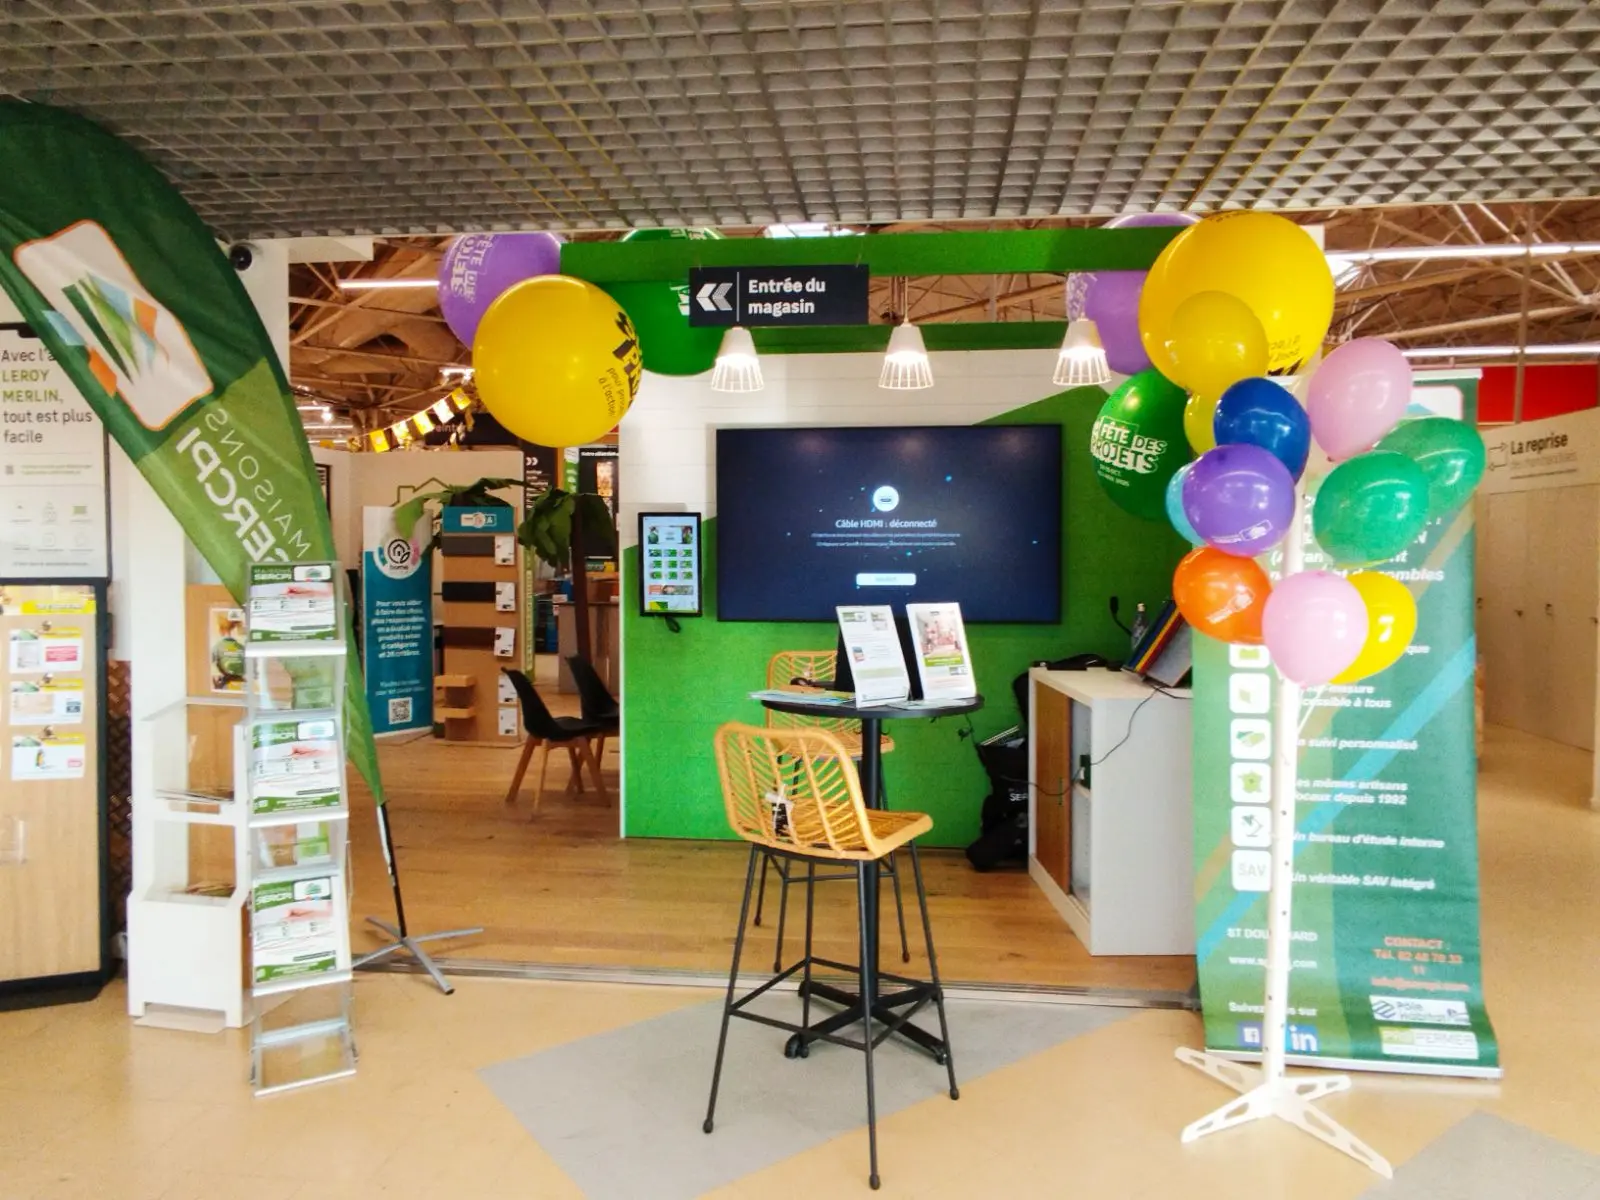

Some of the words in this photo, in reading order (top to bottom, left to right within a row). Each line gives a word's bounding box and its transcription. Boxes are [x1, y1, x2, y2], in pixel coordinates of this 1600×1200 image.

[748, 278, 802, 293] Entrée
[805, 277, 826, 293] du
[748, 299, 815, 317] magasin
[2, 349, 36, 362] Avec
[2, 369, 49, 382] LEROY
[3, 389, 64, 403] MERLIN,
[4, 410, 32, 423] tout
[36, 410, 58, 423] est
[62, 408, 93, 426] plus
[4, 428, 43, 443] facile
[1133, 434, 1168, 454] DES
[1511, 441, 1524, 455] La
[1526, 432, 1569, 455] reprise
[835, 519, 859, 529] Câble
[860, 520, 884, 528] HDMI
[889, 519, 938, 529] déconnecté
[1364, 699, 1393, 709] tous
[1308, 737, 1337, 749] suivi
[1338, 738, 1419, 751] personnalisé
[1358, 779, 1409, 791] artisans
[1333, 792, 1375, 805] depuis
[1308, 833, 1350, 844] bureau
[1352, 833, 1398, 846] d'étude
[1399, 835, 1445, 849] interne
[1237, 862, 1267, 877] SAV
[1309, 873, 1360, 886] véritable
[1361, 874, 1389, 887] SAV
[1390, 876, 1436, 892] intégré
[1227, 927, 1242, 938] ST
[1384, 936, 1443, 950] CONTACT
[1289, 1025, 1318, 1051] in
